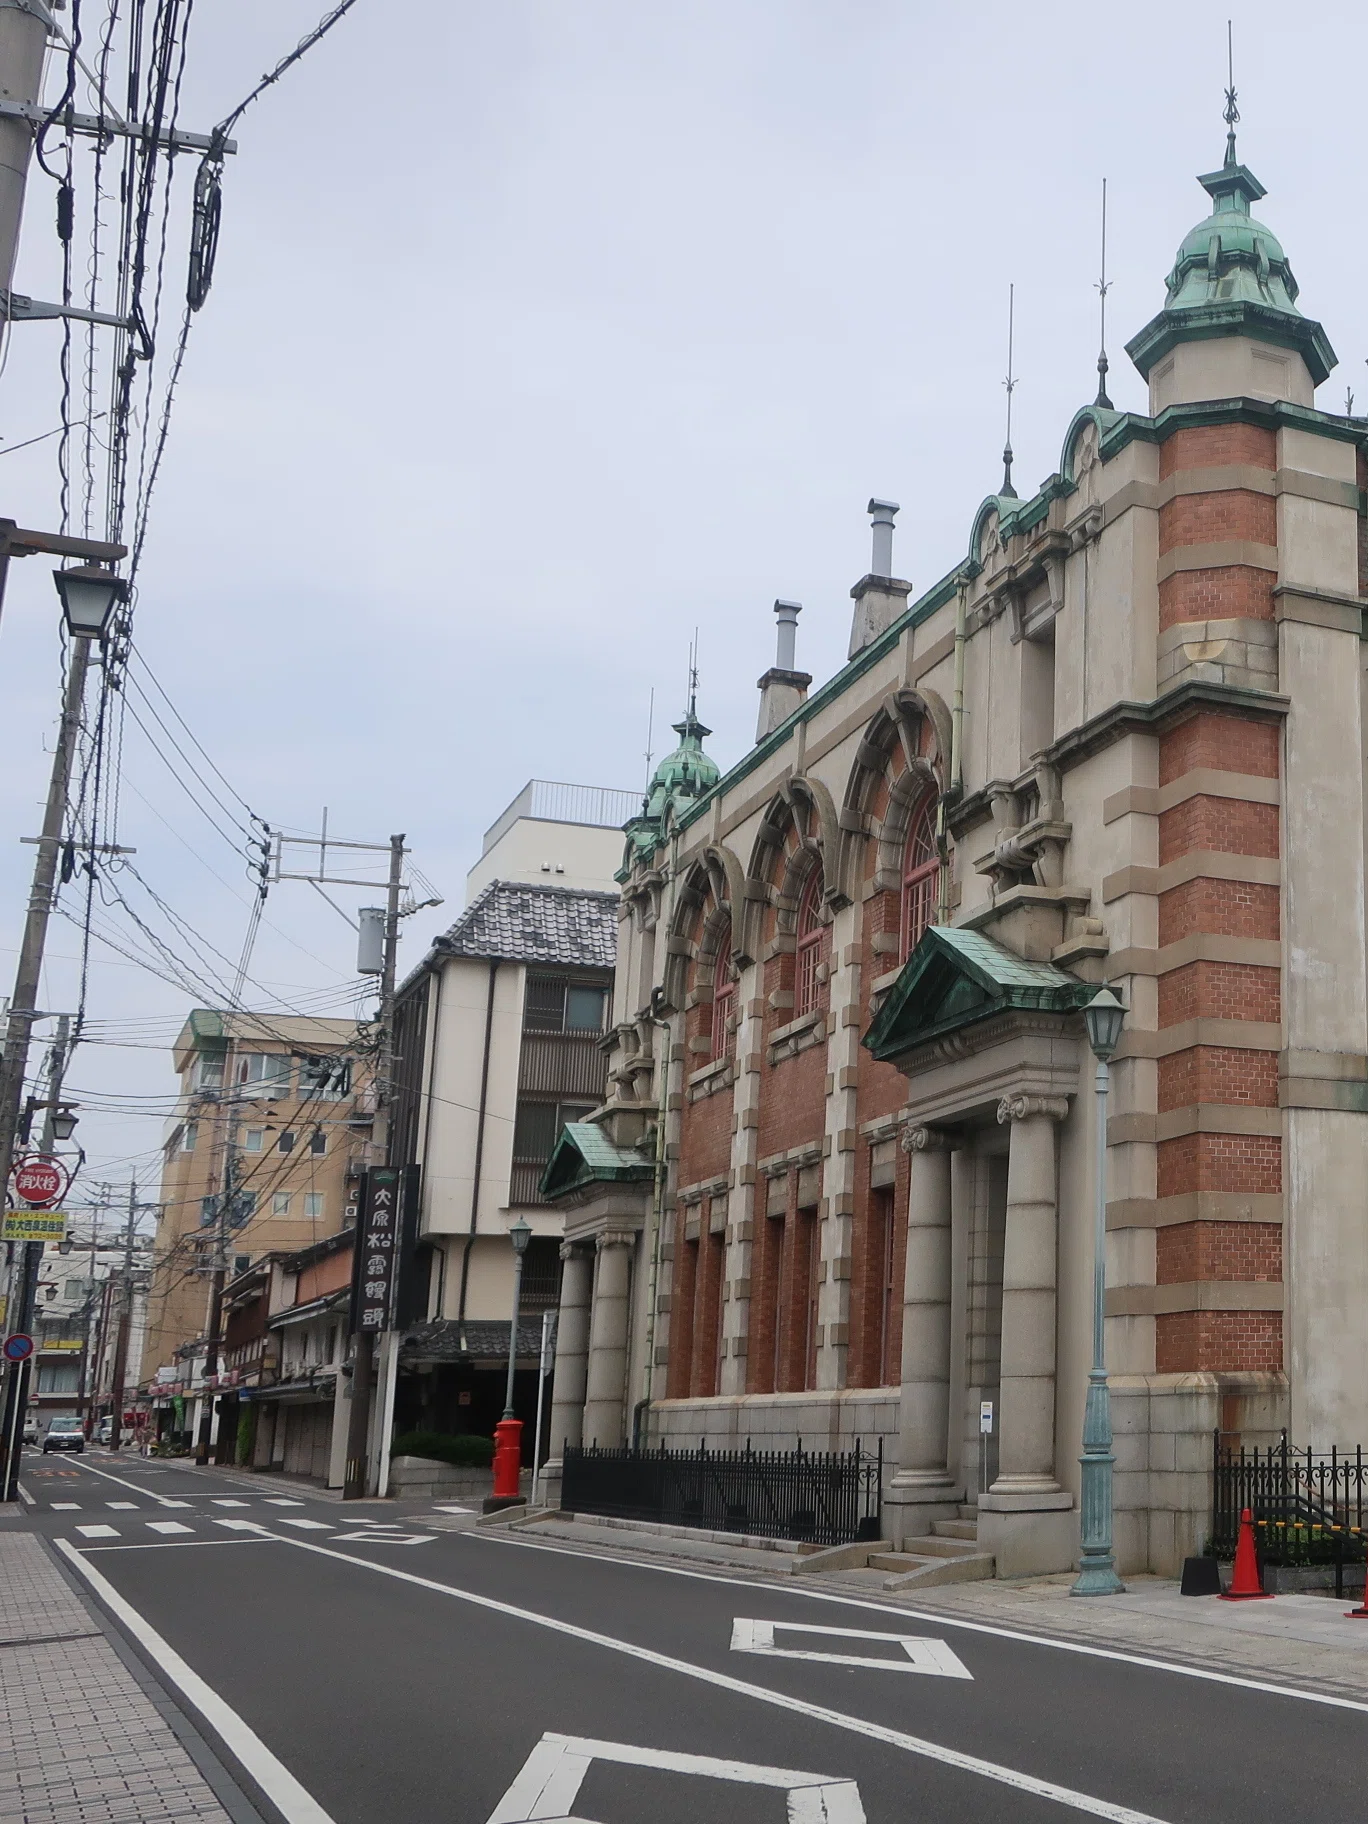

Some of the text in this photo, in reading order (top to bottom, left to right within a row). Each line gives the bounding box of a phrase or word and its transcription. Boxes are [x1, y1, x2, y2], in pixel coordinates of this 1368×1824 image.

[18, 1174, 57, 1191] 消火栓
[362, 1188, 392, 1329] 大原松露饅頭
